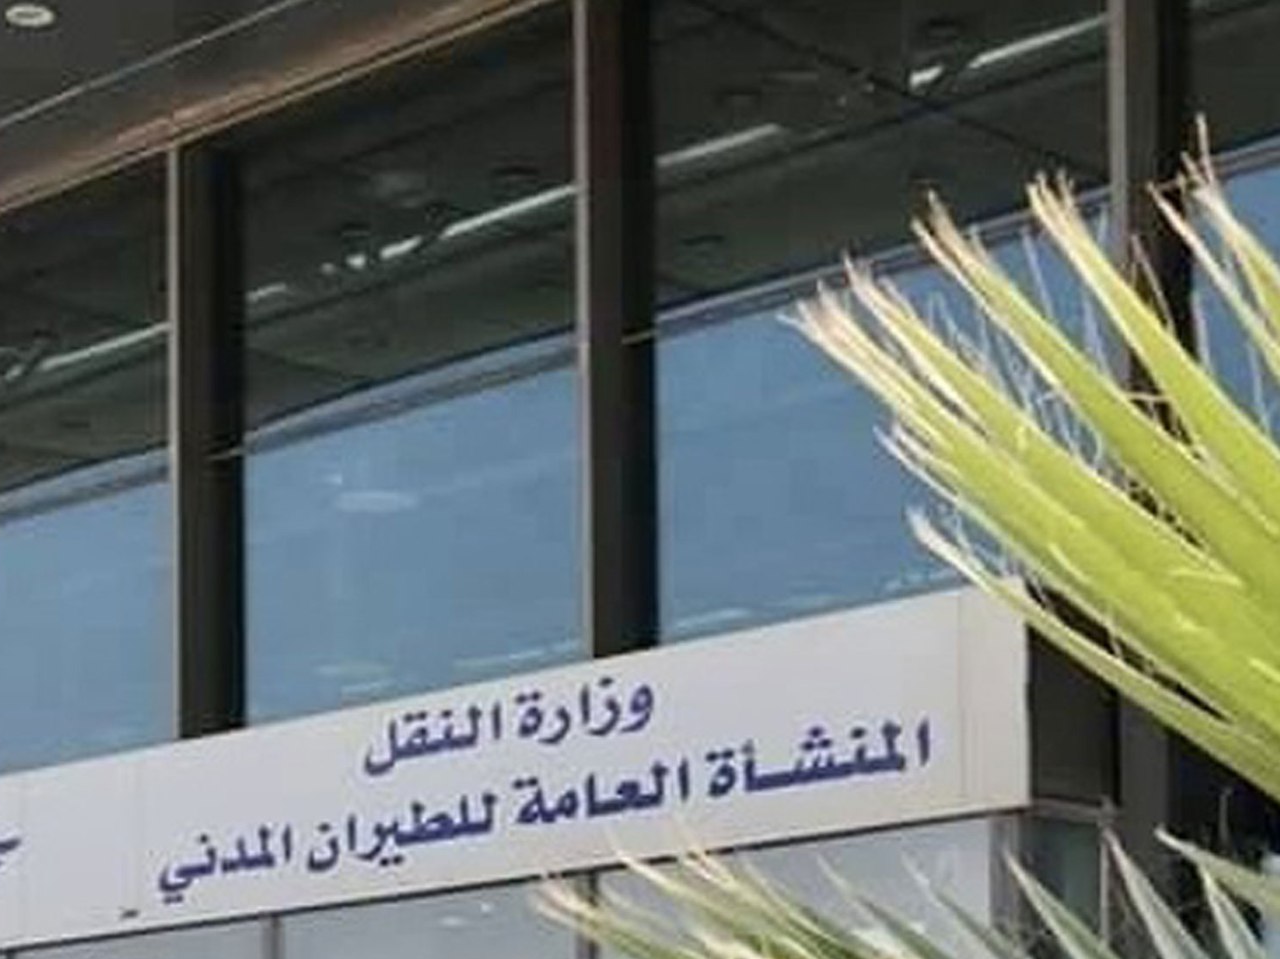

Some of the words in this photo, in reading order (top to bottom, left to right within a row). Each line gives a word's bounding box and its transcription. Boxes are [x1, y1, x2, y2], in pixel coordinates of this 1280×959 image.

[364, 701, 502, 776] النقل
[514, 677, 654, 745] وزارة
[512, 757, 690, 824] العامة
[705, 719, 931, 798] المنشأة
[158, 824, 291, 904] المدني
[308, 793, 498, 871] للطيران
